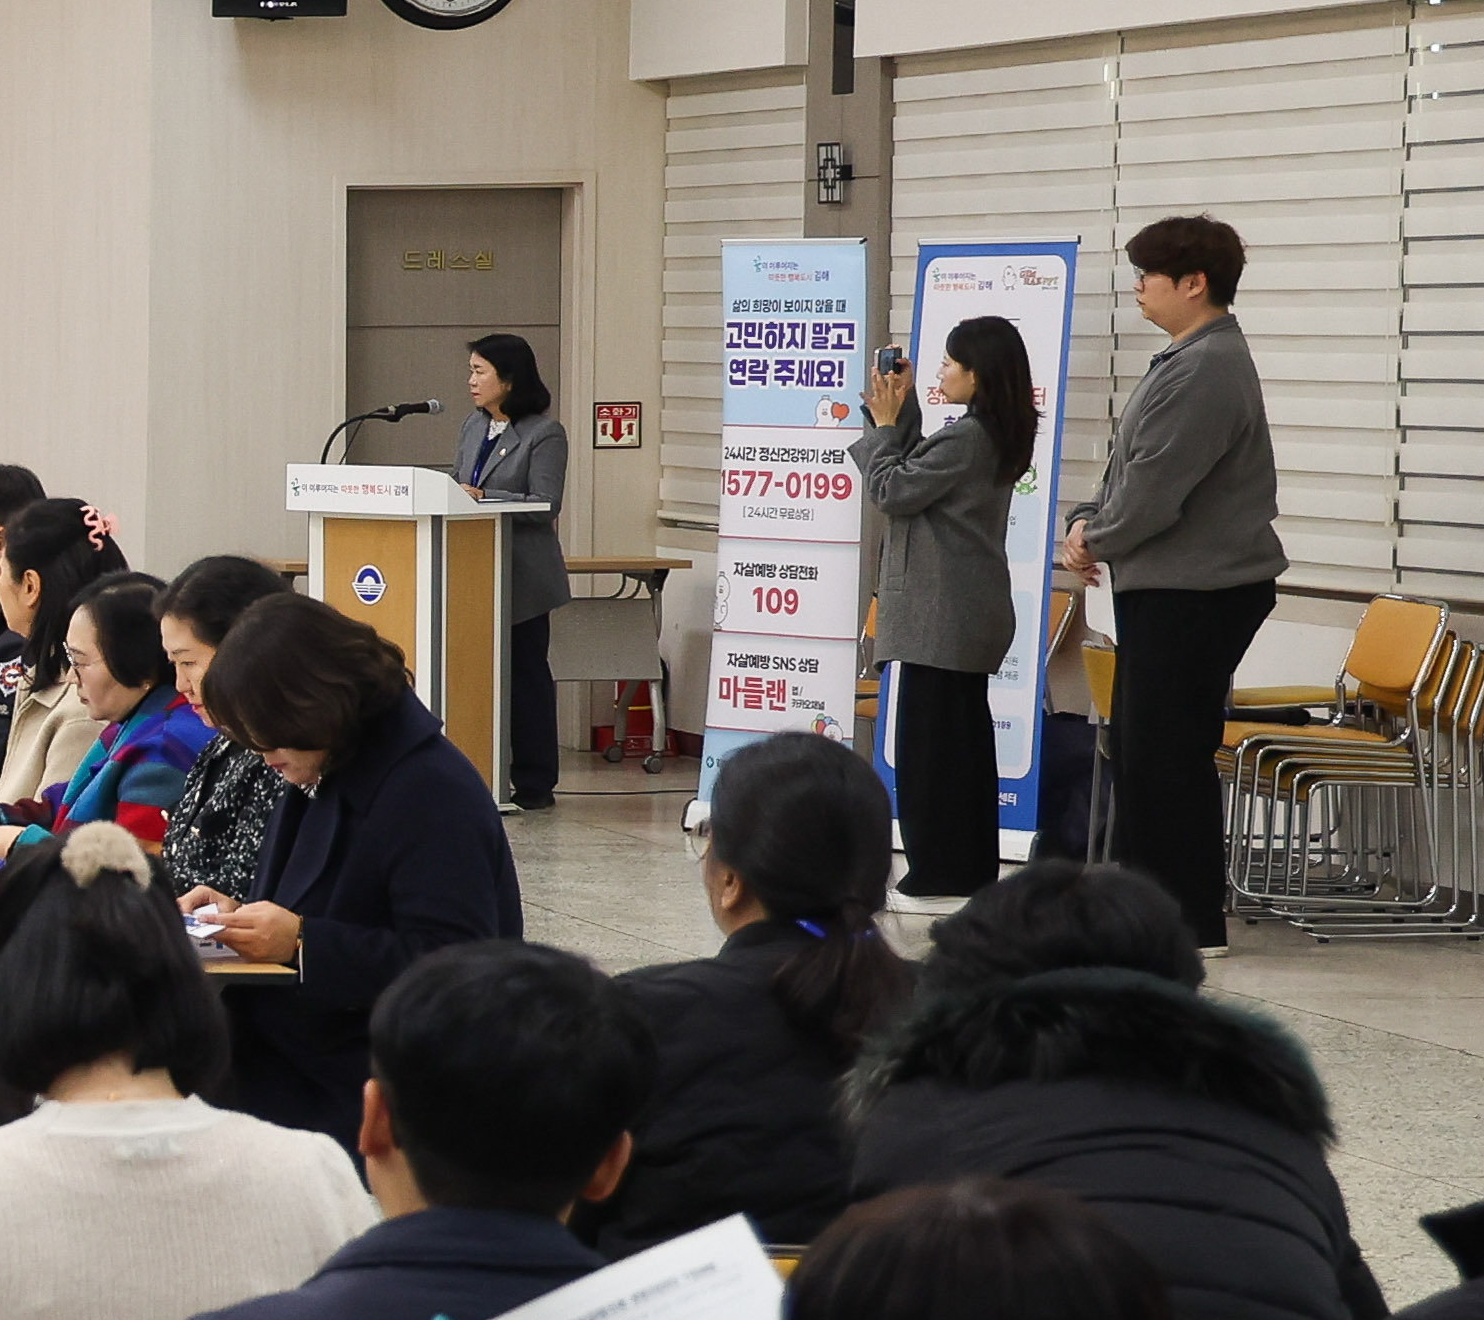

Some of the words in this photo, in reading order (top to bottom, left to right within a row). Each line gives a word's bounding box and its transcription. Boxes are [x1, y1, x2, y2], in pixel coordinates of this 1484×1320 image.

[403, 249, 493, 271] 드레스실
[815, 270, 830, 282] 김해
[732, 299, 751, 313] 삶의
[752, 299, 782, 313] 희망이
[784, 299, 813, 313] 보이지
[815, 299, 834, 313] 않을
[725, 321, 807, 350] 고민하지
[811, 322, 856, 350] 말고
[729, 358, 770, 387] 연락
[773, 359, 845, 388] 주세요!
[599, 407, 636, 416] 소화기
[724, 446, 757, 462] 24시간
[759, 447, 819, 463] 정신건강위기
[821, 449, 846, 464] 상담
[394, 485, 409, 497] 김해
[721, 469, 852, 500] 1577-0199
[733, 562, 777, 578] 자살예방
[778, 564, 818, 581] 상담전화
[753, 586, 799, 615] 109
[727, 652, 770, 670] 자살예방
[772, 656, 797, 671] SNS
[798, 658, 819, 674] 상담
[718, 675, 786, 712] 마들랜
